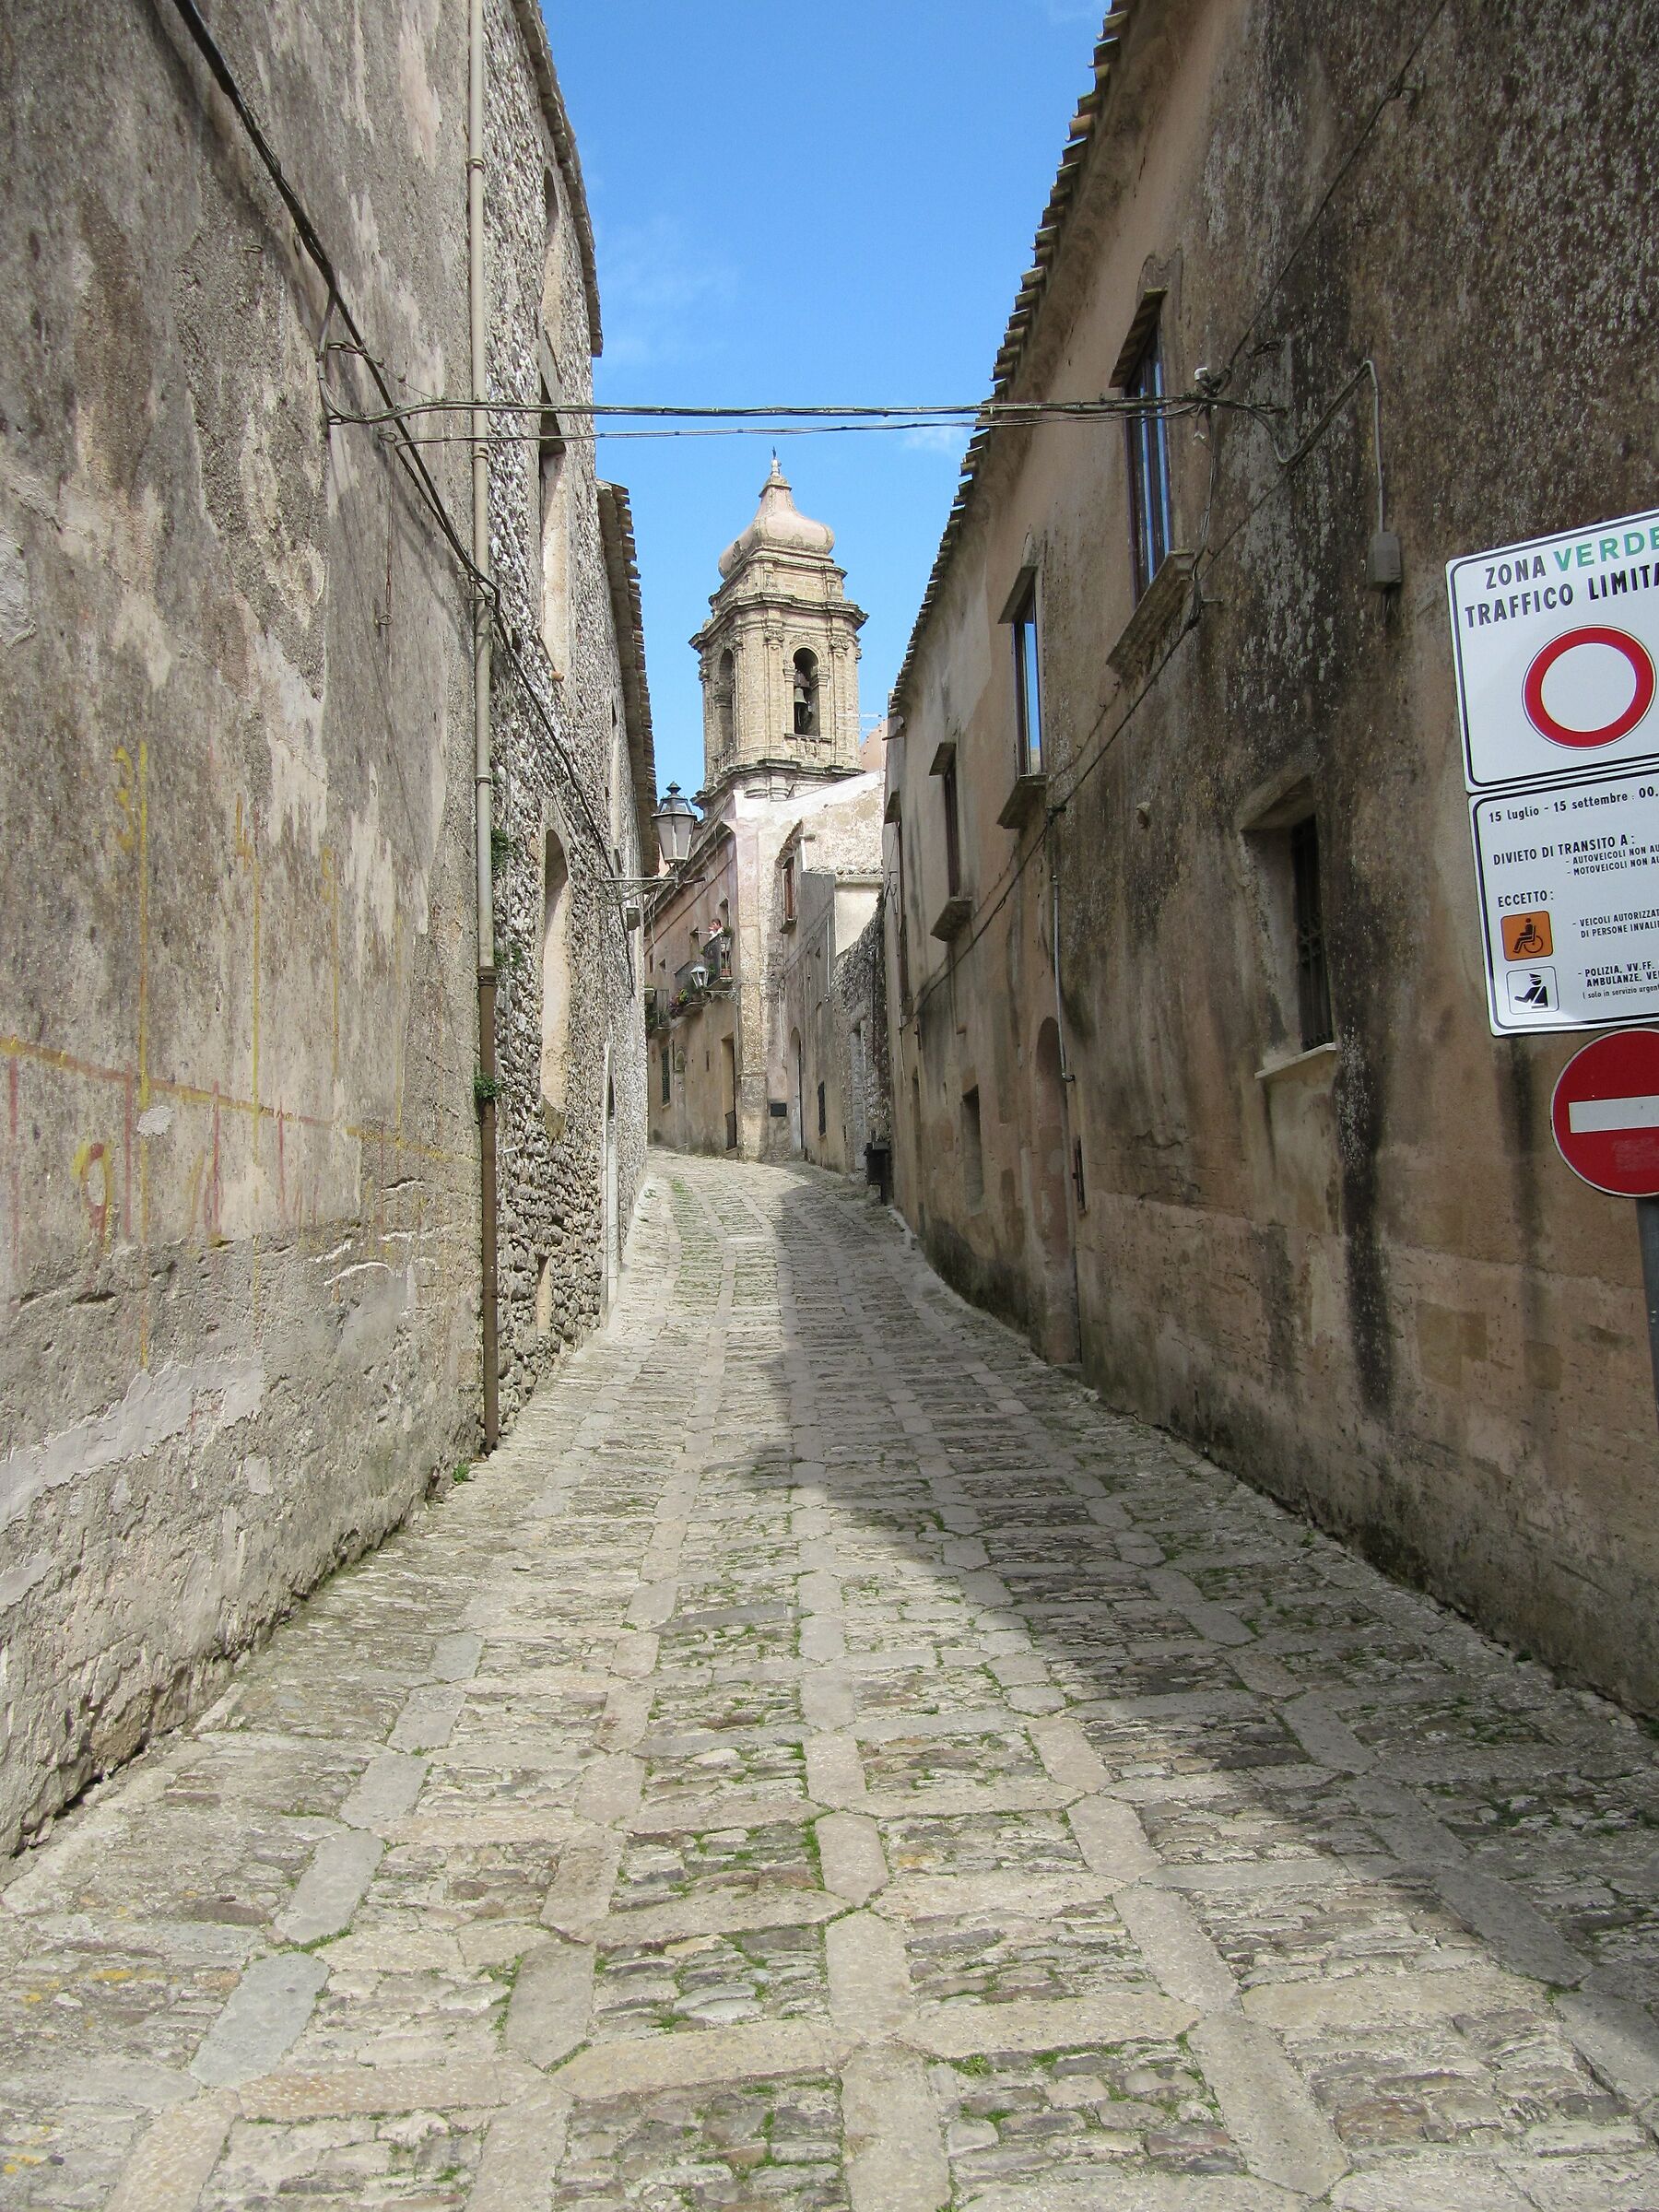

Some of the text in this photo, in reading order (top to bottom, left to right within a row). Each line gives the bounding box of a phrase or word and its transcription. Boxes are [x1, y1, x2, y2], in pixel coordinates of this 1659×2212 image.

[1485, 555, 1547, 590] ZONA
[1464, 583, 1573, 628] TRAFFICO
[1489, 811, 1501, 823] 15
[1507, 806, 1540, 821] luglio
[1553, 800, 1567, 813] 15
[1493, 848, 1537, 865] DIVIETO
[1542, 845, 1554, 858] DI
[1558, 836, 1616, 855] TRANSITO
[1572, 850, 1626, 865] AUTOVEICOLI
[1630, 846, 1646, 856] NON
[1574, 861, 1627, 876] MOTOVEICOLI
[1630, 857, 1648, 868] NON
[1579, 915, 1611, 927] VEICOLI
[1581, 929, 1590, 938] DI
[1592, 924, 1628, 936] PERSONE
[1612, 986, 1637, 996] servizio
